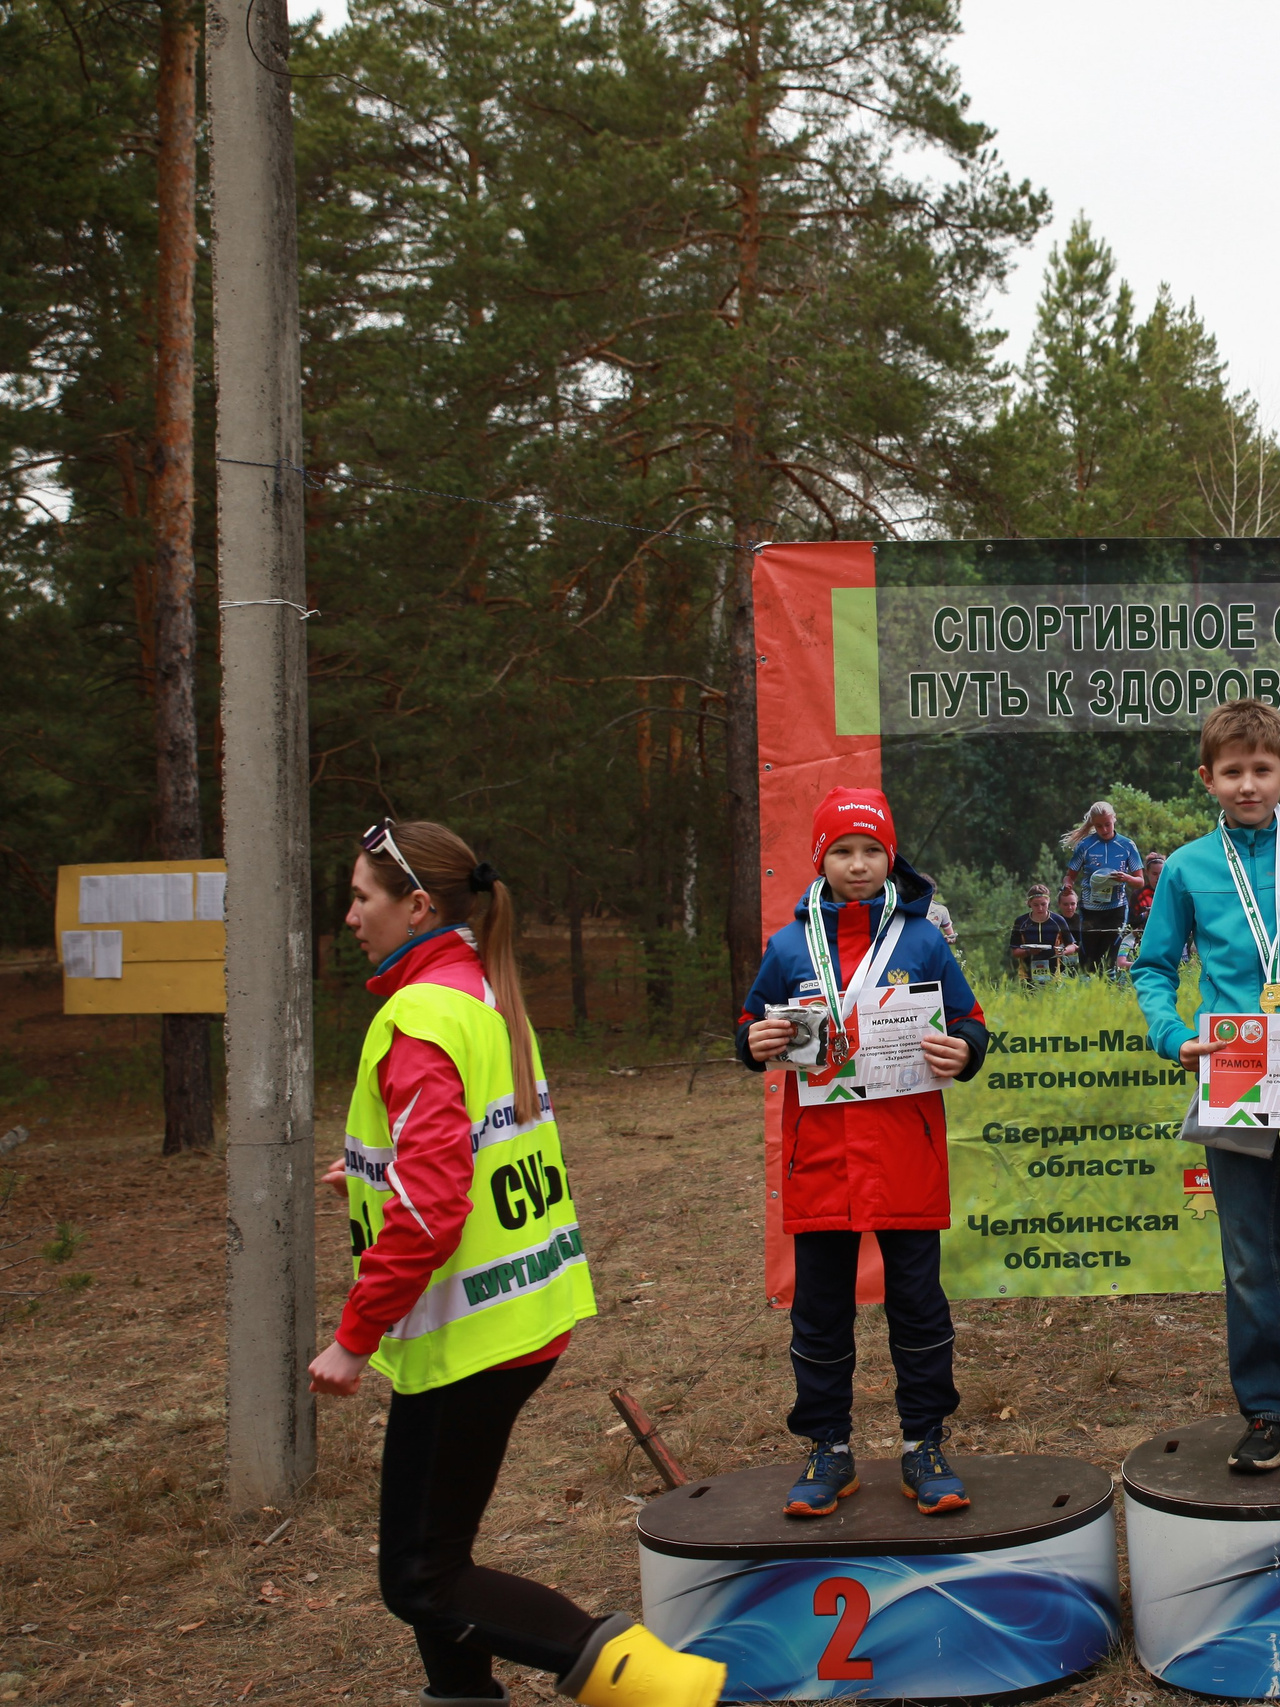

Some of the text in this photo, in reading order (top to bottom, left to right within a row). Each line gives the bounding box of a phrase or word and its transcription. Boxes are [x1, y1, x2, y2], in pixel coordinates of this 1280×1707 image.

[933, 603, 1257, 653] СПОРТИВНОЕ
[909, 671, 1029, 719] ПУТЬ
[1047, 670, 1074, 716] К
[838, 803, 877, 813] helvetia
[872, 1015, 918, 1026] НАГРАЖДАЕТ
[987, 1029, 1153, 1054] Ханты-Ма
[988, 1063, 1186, 1089] автономный
[1215, 1058, 1263, 1069] ГРАМОТА
[982, 1120, 1184, 1148] Свердловска
[1027, 1155, 1155, 1178] область
[968, 1211, 1179, 1236] Челябинская
[1004, 1246, 1131, 1270] область
[814, 1577, 873, 1680] 2
